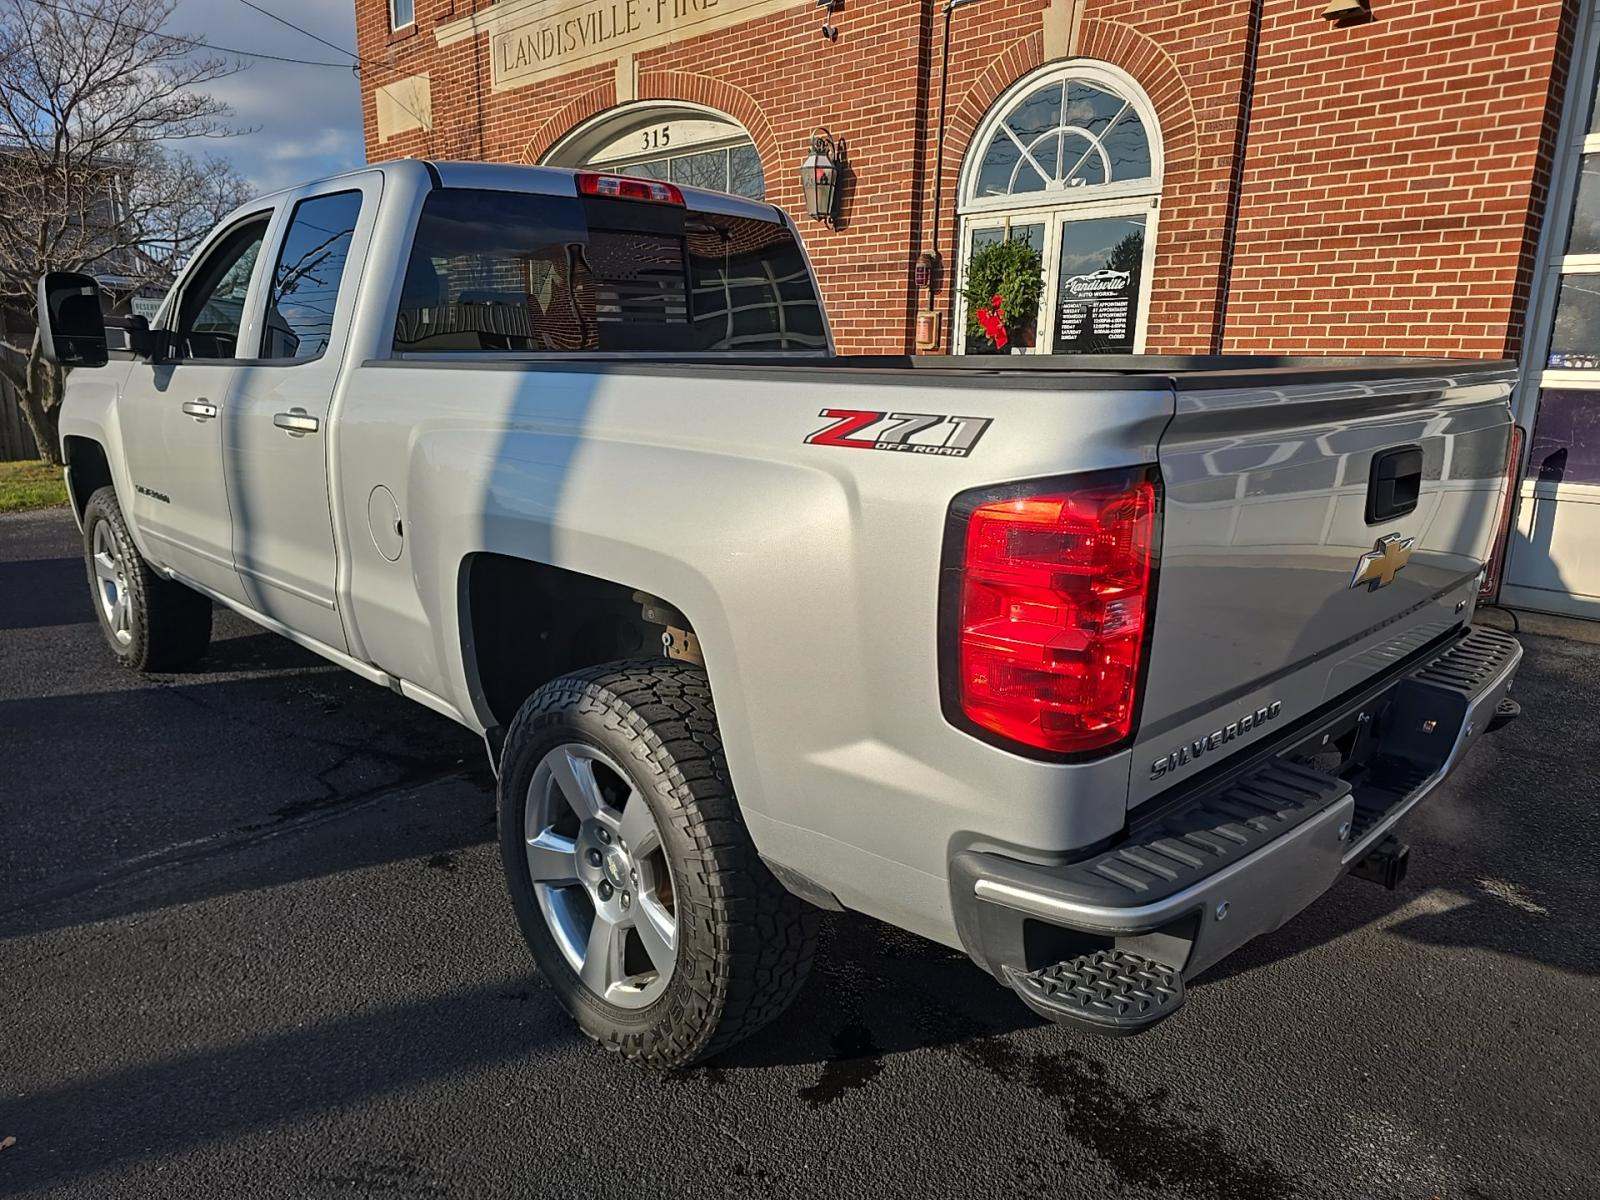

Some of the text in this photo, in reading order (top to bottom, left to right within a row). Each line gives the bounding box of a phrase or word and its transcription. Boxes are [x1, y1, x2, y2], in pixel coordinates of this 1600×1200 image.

[503, 0, 718, 72] LANDISVILLE FI
[641, 125, 671, 150] 315
[1070, 278, 1126, 295] Landisville
[803, 408, 994, 450] Z71
[875, 442, 968, 457] OFF ROAD
[1150, 700, 1281, 781] SILVERADO
